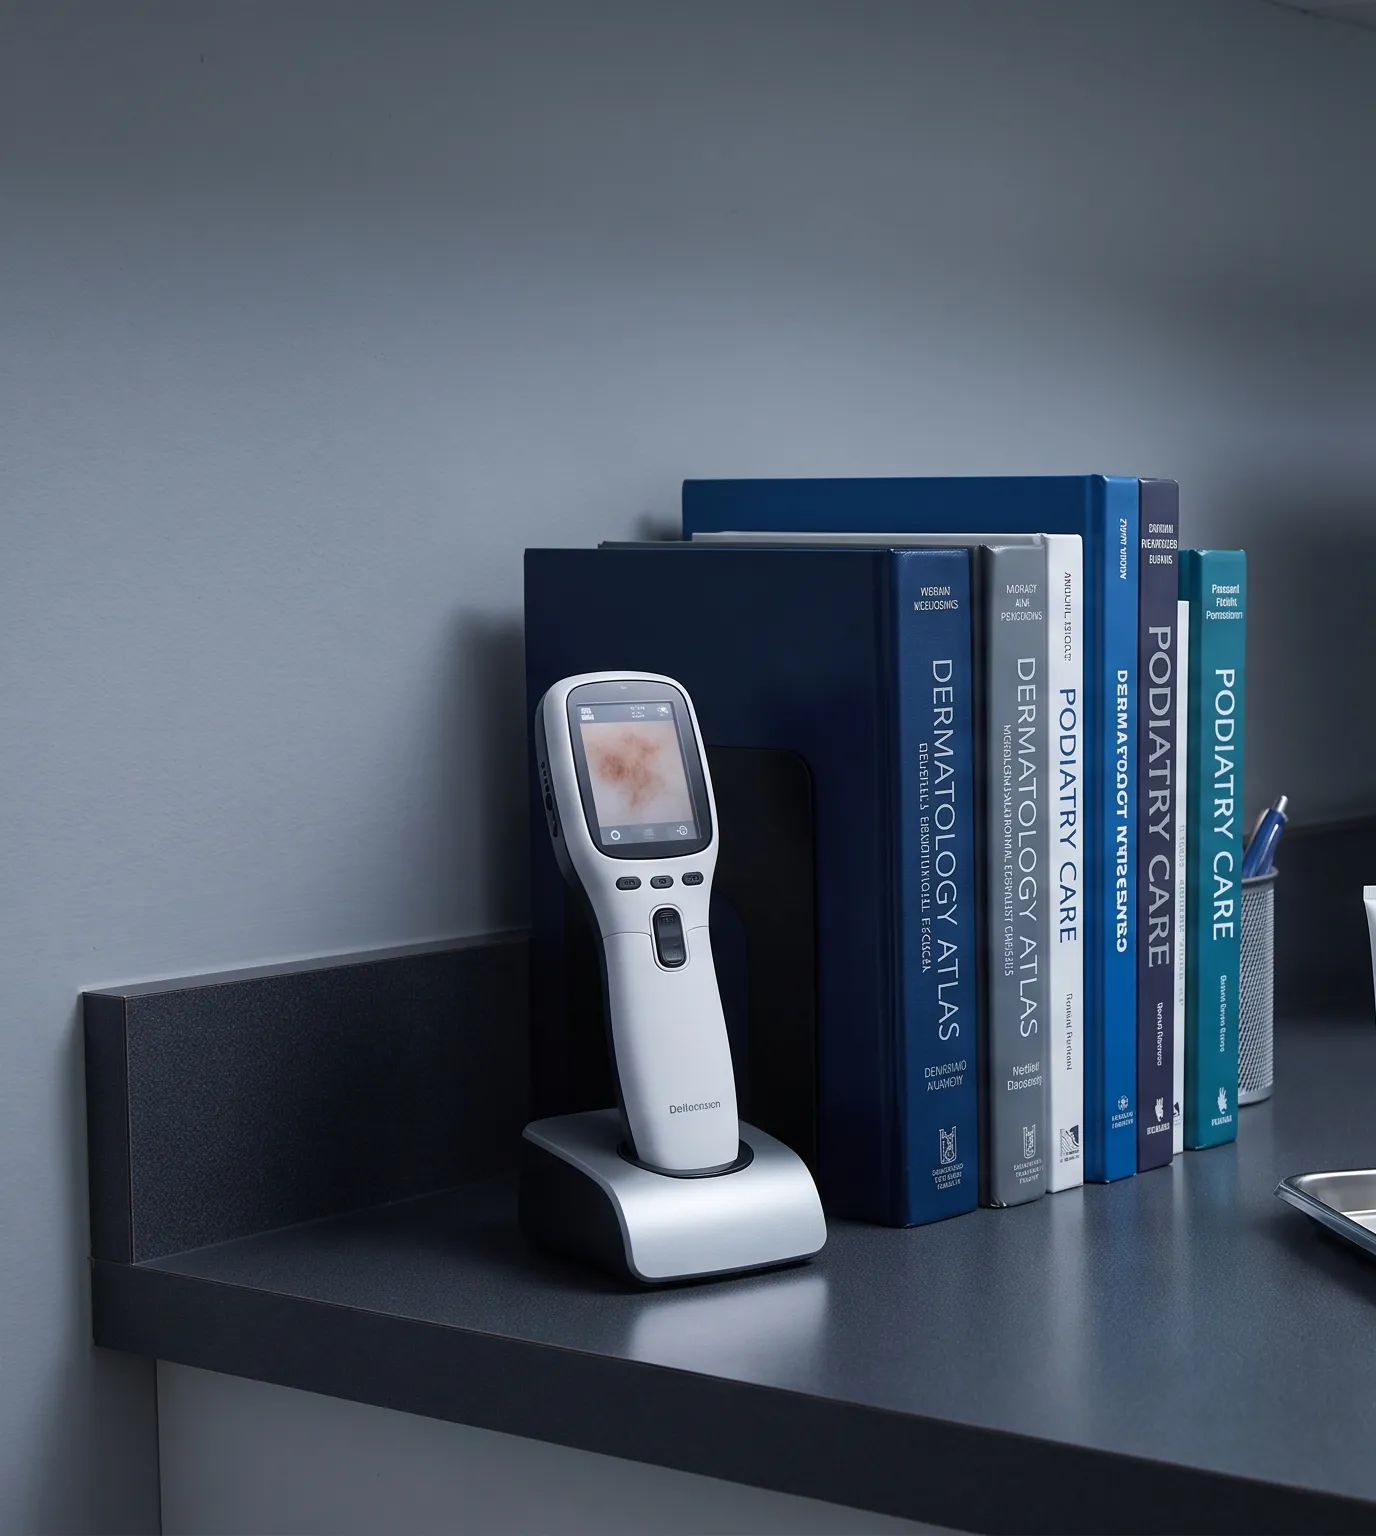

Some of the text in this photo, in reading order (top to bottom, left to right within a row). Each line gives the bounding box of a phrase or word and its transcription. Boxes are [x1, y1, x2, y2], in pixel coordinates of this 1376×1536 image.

[932, 659, 958, 926] DERMATOLOGY
[1017, 657, 1039, 1038] DERMATOLOGY ATLAS
[1059, 688, 1077, 944] PODIATRY CARE
[1147, 625, 1172, 968] PODIATRY CARE
[1213, 668, 1236, 941] PODIATRY CARE
[937, 938, 960, 1041] ATLAS
